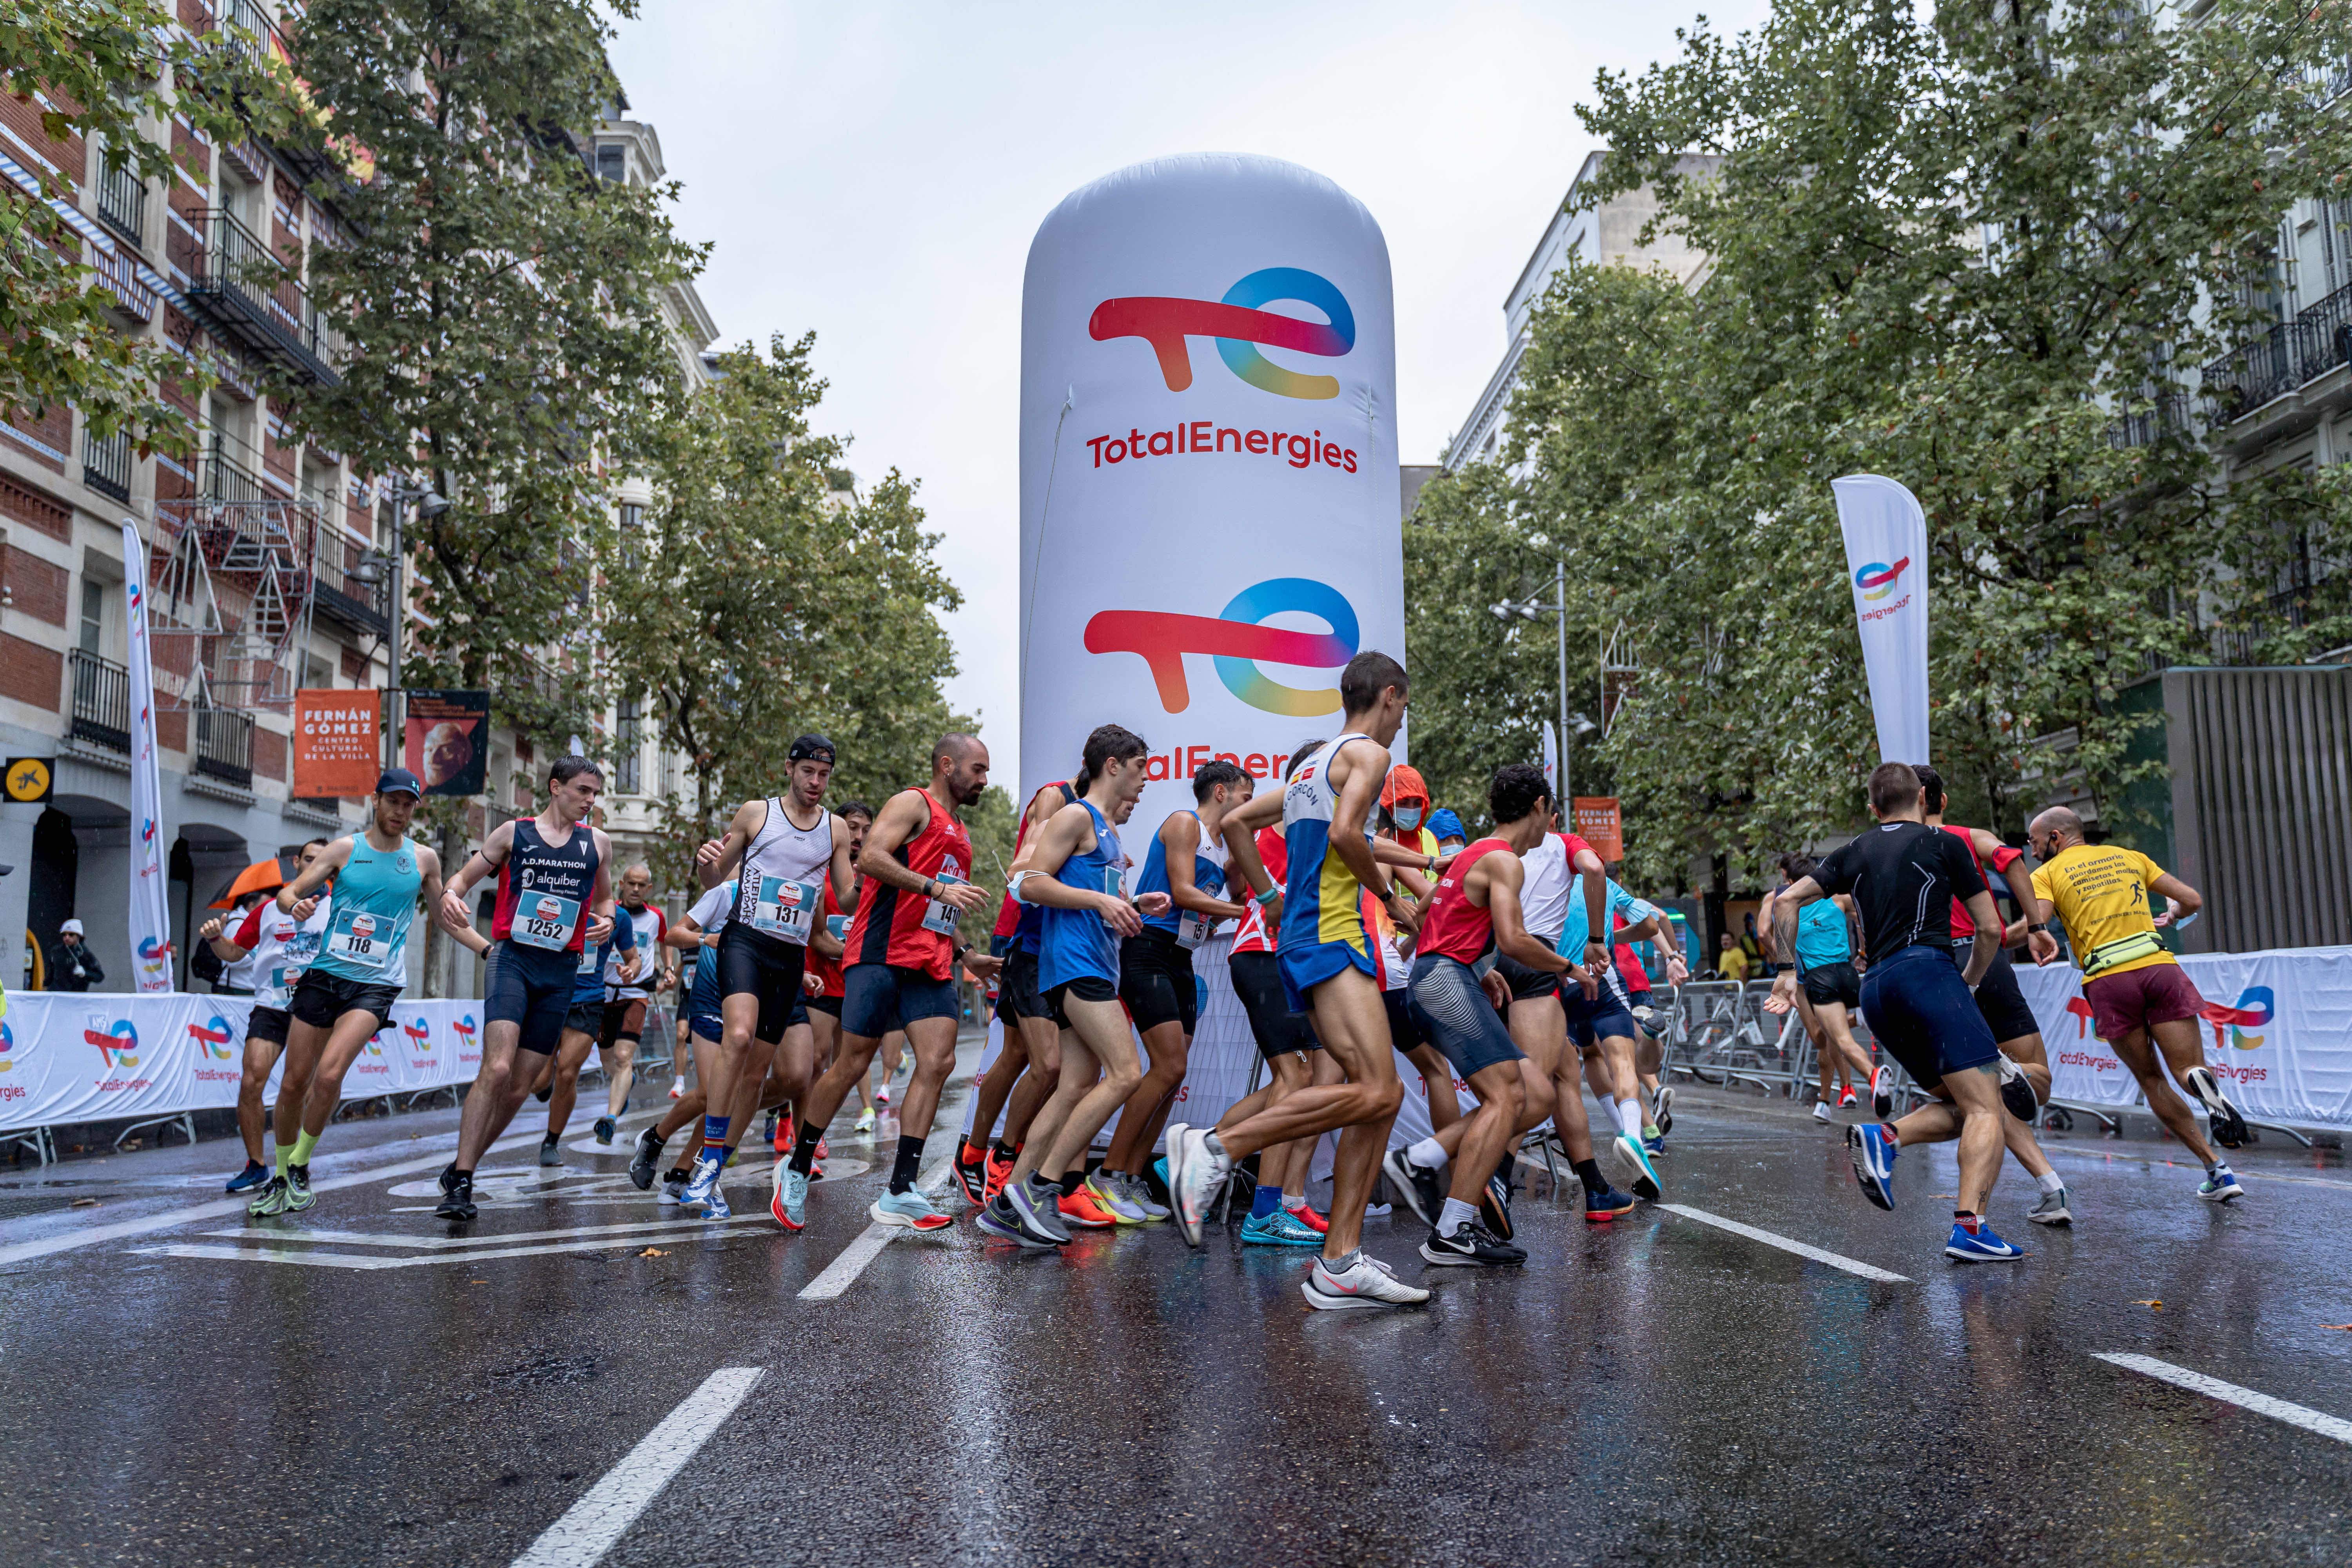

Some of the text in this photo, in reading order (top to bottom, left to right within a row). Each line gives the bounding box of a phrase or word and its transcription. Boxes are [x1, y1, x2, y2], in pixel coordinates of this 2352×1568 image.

[1087, 421, 1357, 474] TotalEnergies
[304, 707, 371, 721] FERNÁN
[304, 721, 371, 734] GÓMEZ
[522, 858, 586, 869] A.D.MARATHON
[2088, 854, 2123, 866] armario
[2069, 865, 2112, 880] guardamos
[2073, 872, 2114, 886] camisetas,
[537, 871, 581, 892] alquiber
[2083, 878, 2123, 891] zapatillas.
[775, 906, 799, 925] 131
[527, 918, 563, 940] 1252
[348, 936, 372, 953] 118
